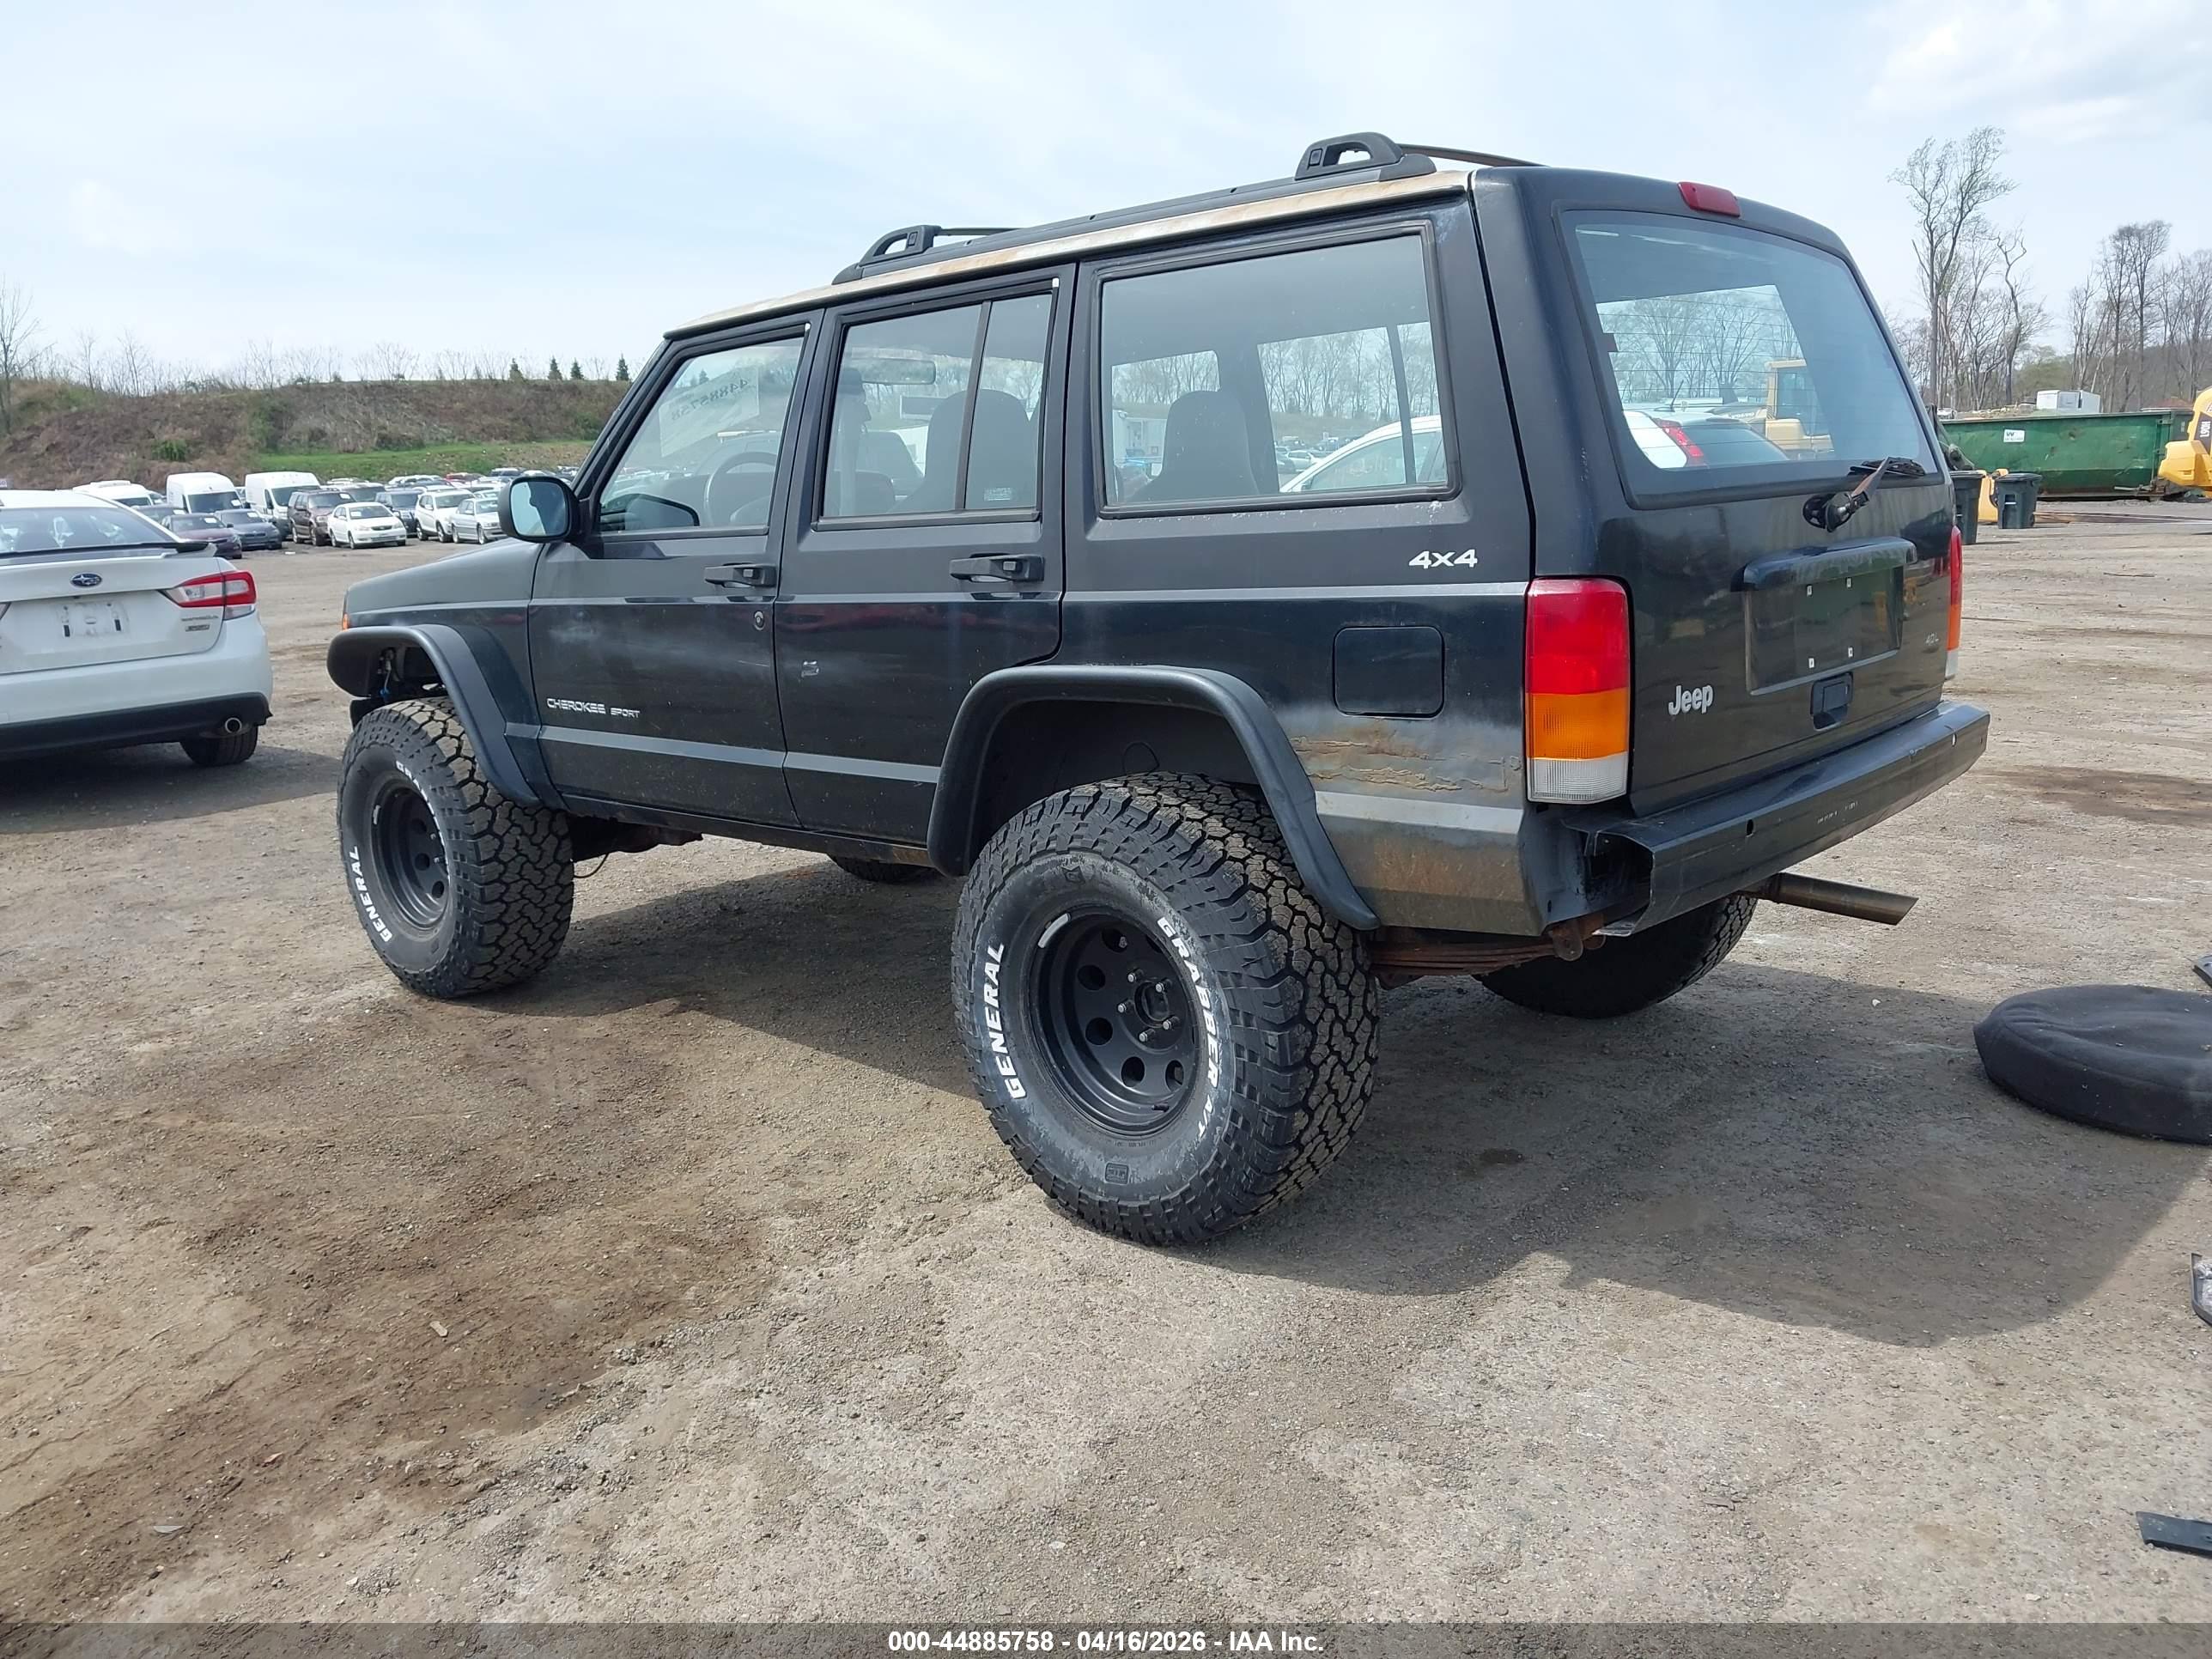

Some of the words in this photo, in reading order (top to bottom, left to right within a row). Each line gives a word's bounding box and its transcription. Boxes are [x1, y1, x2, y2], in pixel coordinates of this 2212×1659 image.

[546, 698, 606, 714] CHEROKEE
[611, 708, 641, 718] SPORT
[1668, 684, 1714, 715] Jeep
[349, 846, 392, 942] GENERAL
[983, 943, 1027, 1099] GENERAL
[1157, 916, 1219, 1088] GRABBER
